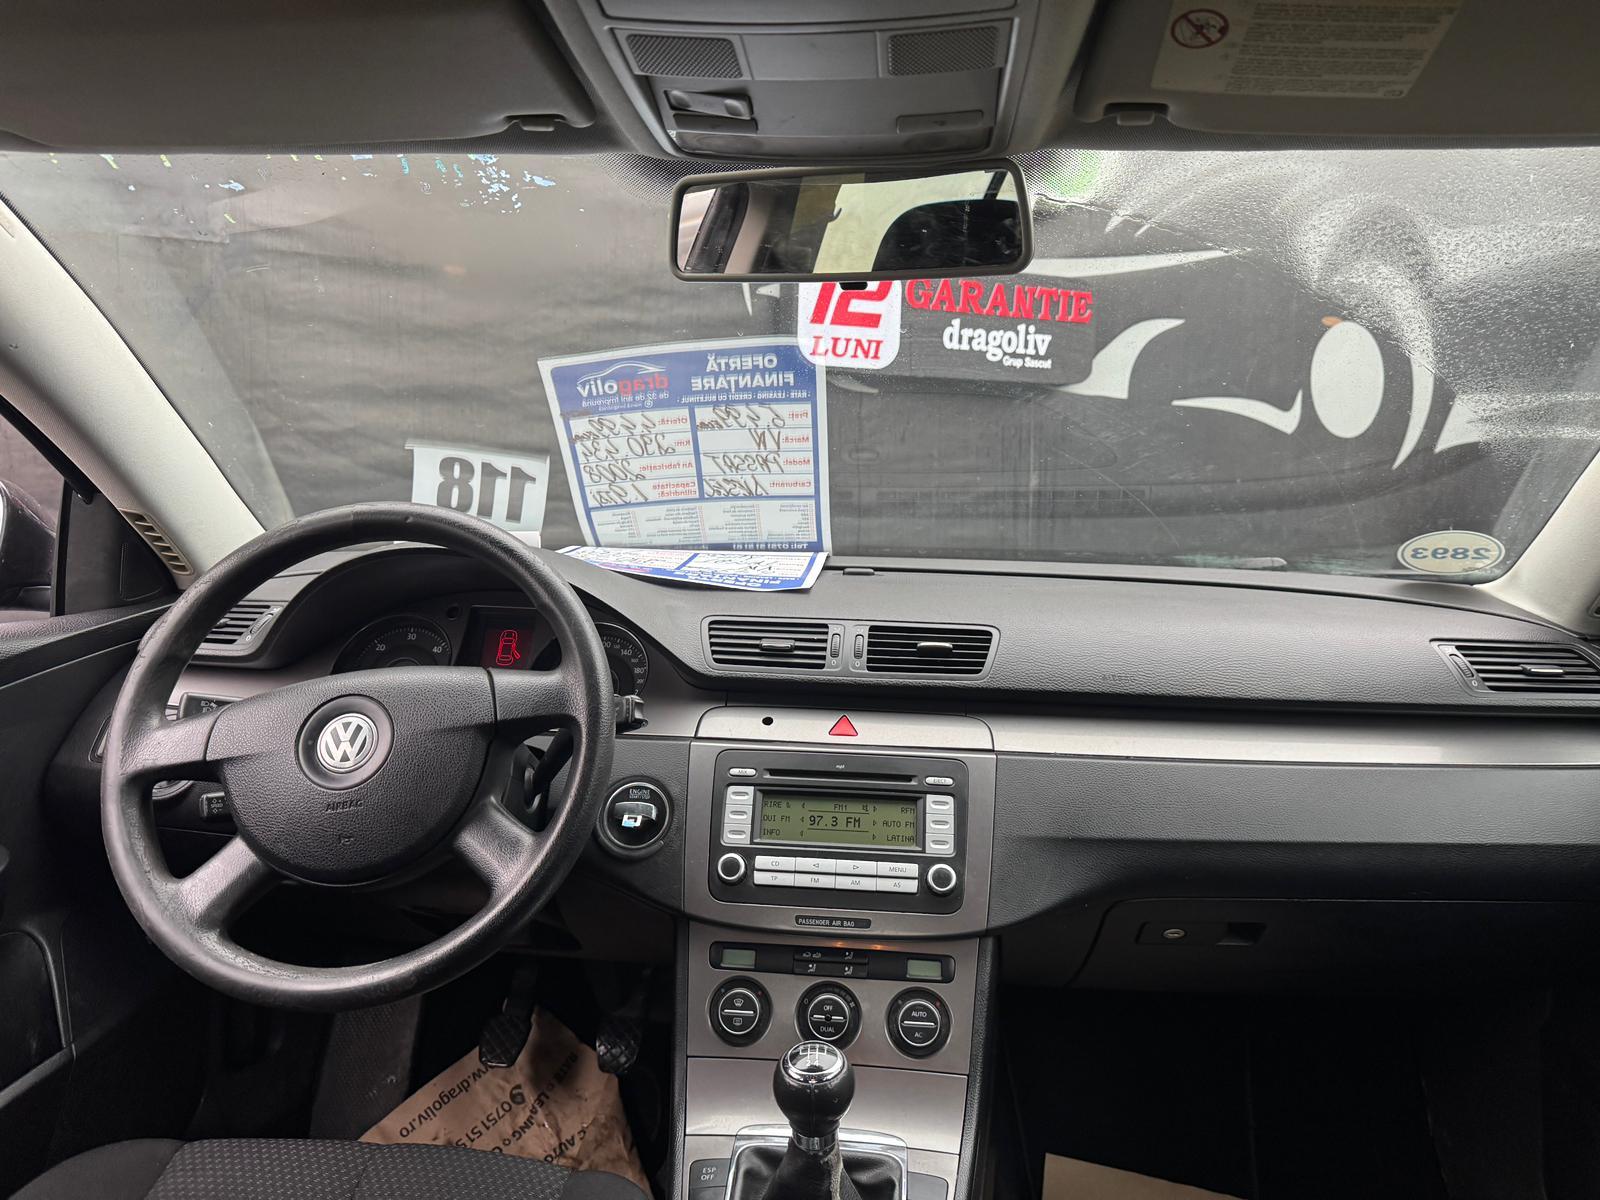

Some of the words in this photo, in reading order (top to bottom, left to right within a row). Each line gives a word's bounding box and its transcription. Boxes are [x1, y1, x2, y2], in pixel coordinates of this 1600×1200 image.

[903, 278, 1094, 324] GARANTIE
[942, 318, 1053, 362] dragoliv
[810, 335, 884, 360] LUNI
[407, 632, 417, 641] 30
[375, 643, 386, 651] 20
[432, 645, 443, 654] 40
[763, 800, 782, 809] RIRE
[900, 807, 916, 815] RFM
[780, 815, 791, 823] FM
[809, 815, 839, 828] 97.3
[845, 817, 861, 828] FM
[882, 820, 902, 828] AUTO
[762, 828, 781, 836] INFO
[886, 834, 915, 843] LATINA
[798, 917, 830, 926] PASSENGER
[831, 919, 842, 927] AIR
[843, 919, 855, 927] BAG
[823, 1004, 833, 1012] OFF
[911, 1010, 928, 1018] AUTO
[820, 1025, 835, 1033] DUAL
[480, 1101, 512, 1131] 0751
[465, 1125, 483, 1143] 51
[702, 1166, 717, 1174] ESP
